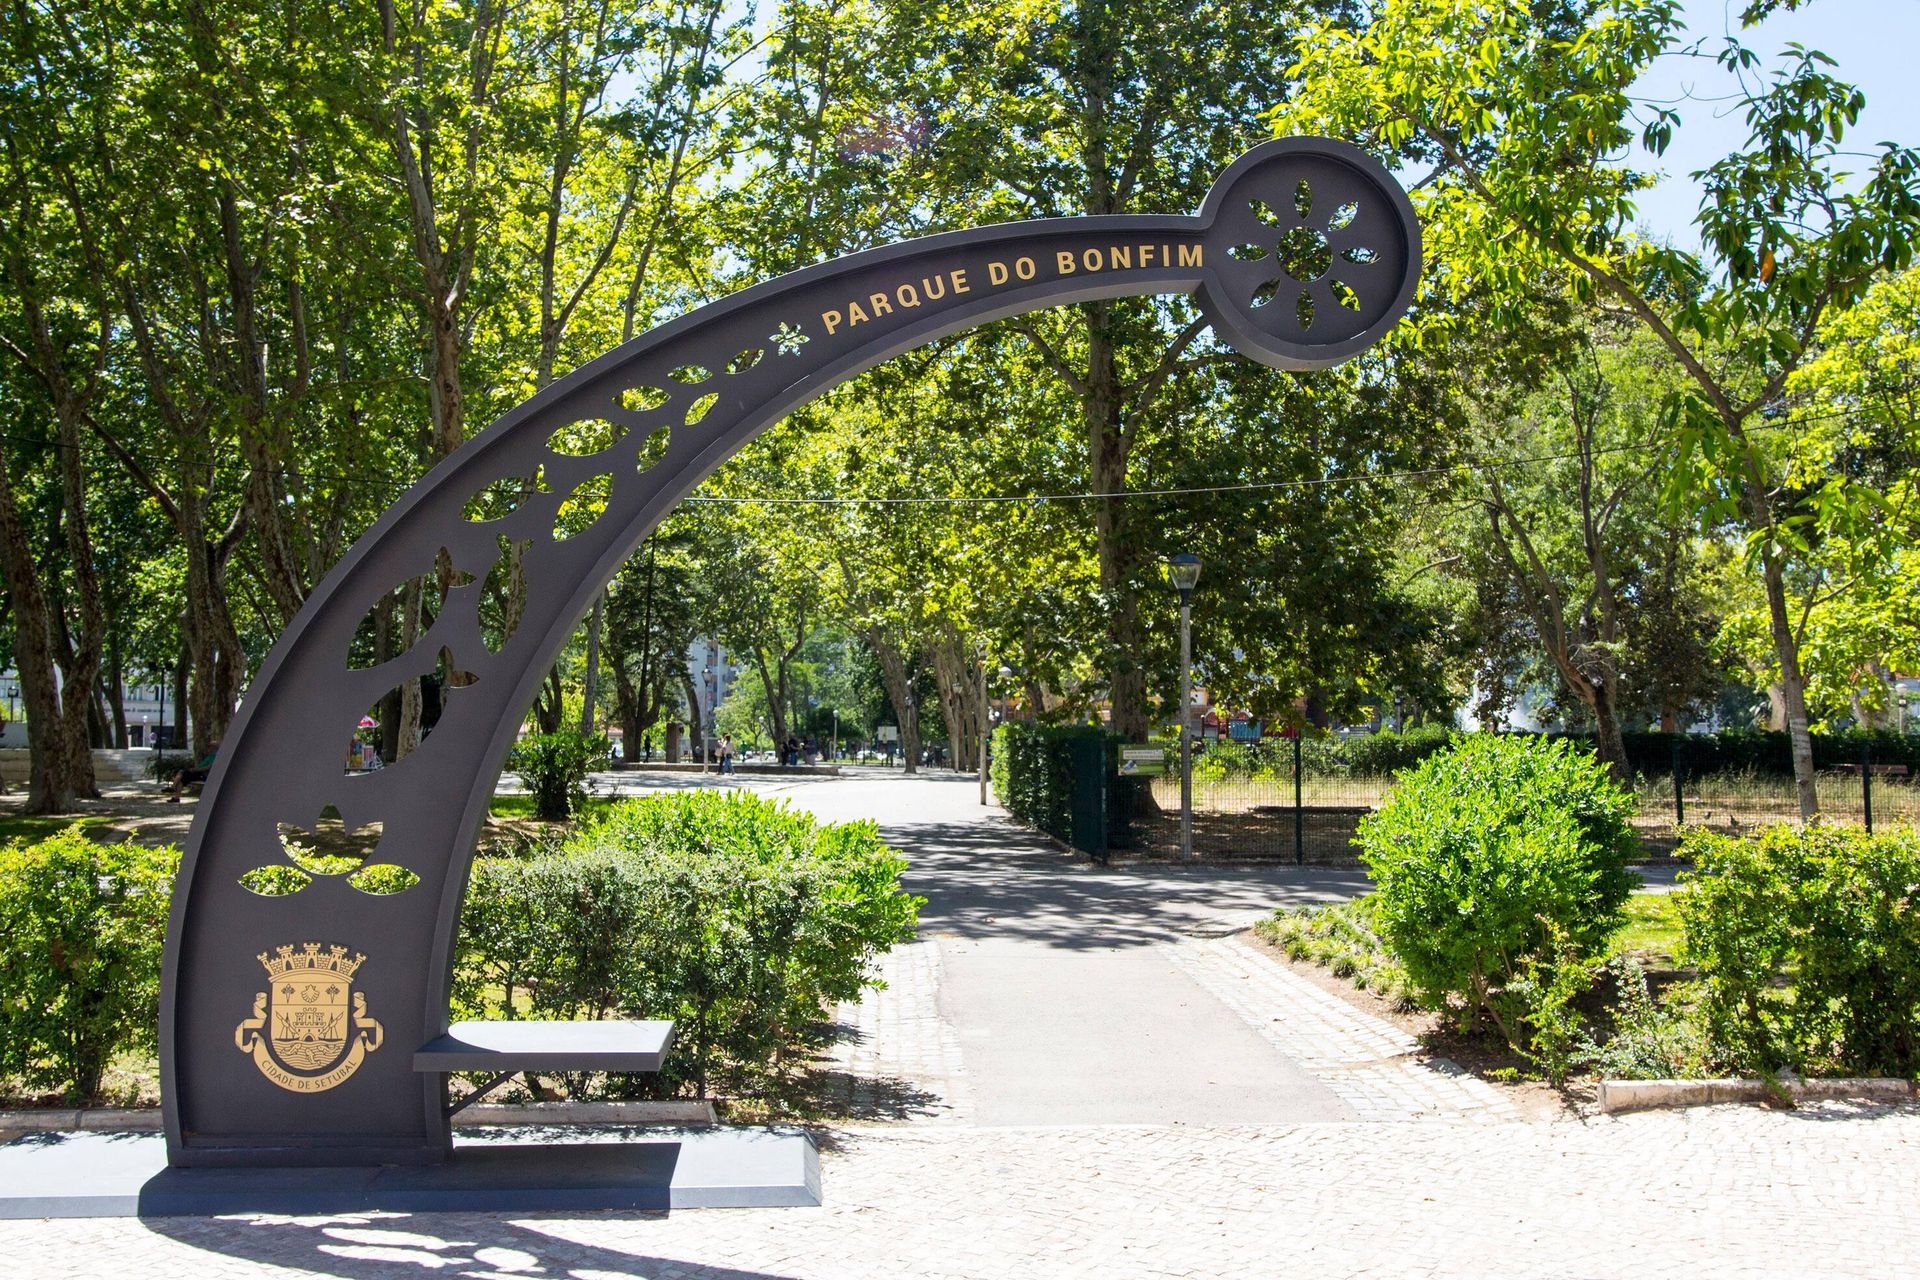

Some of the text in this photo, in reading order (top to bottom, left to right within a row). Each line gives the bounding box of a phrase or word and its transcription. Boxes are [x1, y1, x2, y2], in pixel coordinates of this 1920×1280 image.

[821, 244, 1204, 335] PARQUE DO BONFIM
[261, 1060, 295, 1086] CIDADE
[297, 1080, 311, 1090] DE
